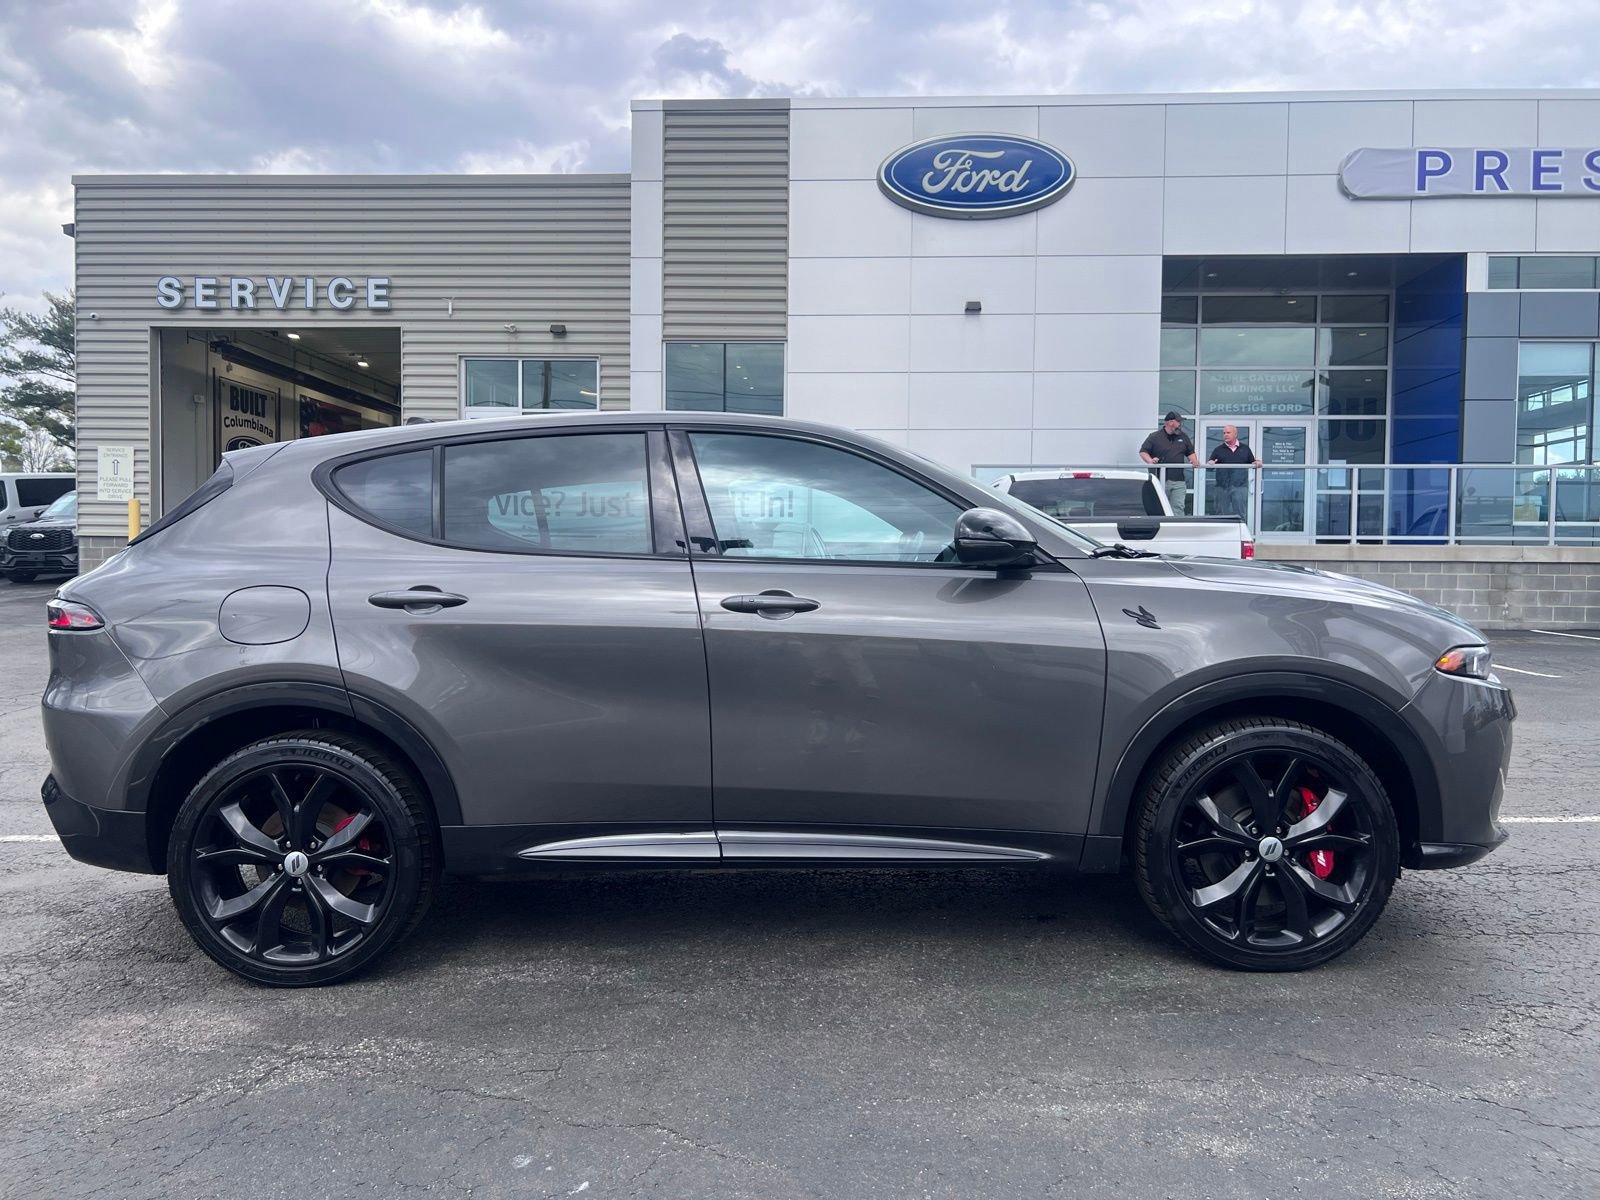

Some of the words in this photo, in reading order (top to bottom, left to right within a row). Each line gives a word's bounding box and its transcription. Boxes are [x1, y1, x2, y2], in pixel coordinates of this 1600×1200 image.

[922, 149, 1033, 194] Ford
[157, 276, 392, 310] SERVICE
[1217, 384, 1273, 393] HOLDINGS
[1276, 384, 1297, 393] LLC
[1249, 374, 1302, 382] GATEWAY
[230, 385, 267, 418] BUILT
[1209, 403, 1268, 412] PRESTIGE
[1271, 403, 1303, 412] FORD
[223, 415, 274, 439] Columbiana
[576, 491, 635, 517] Just
[760, 489, 794, 518] In!
